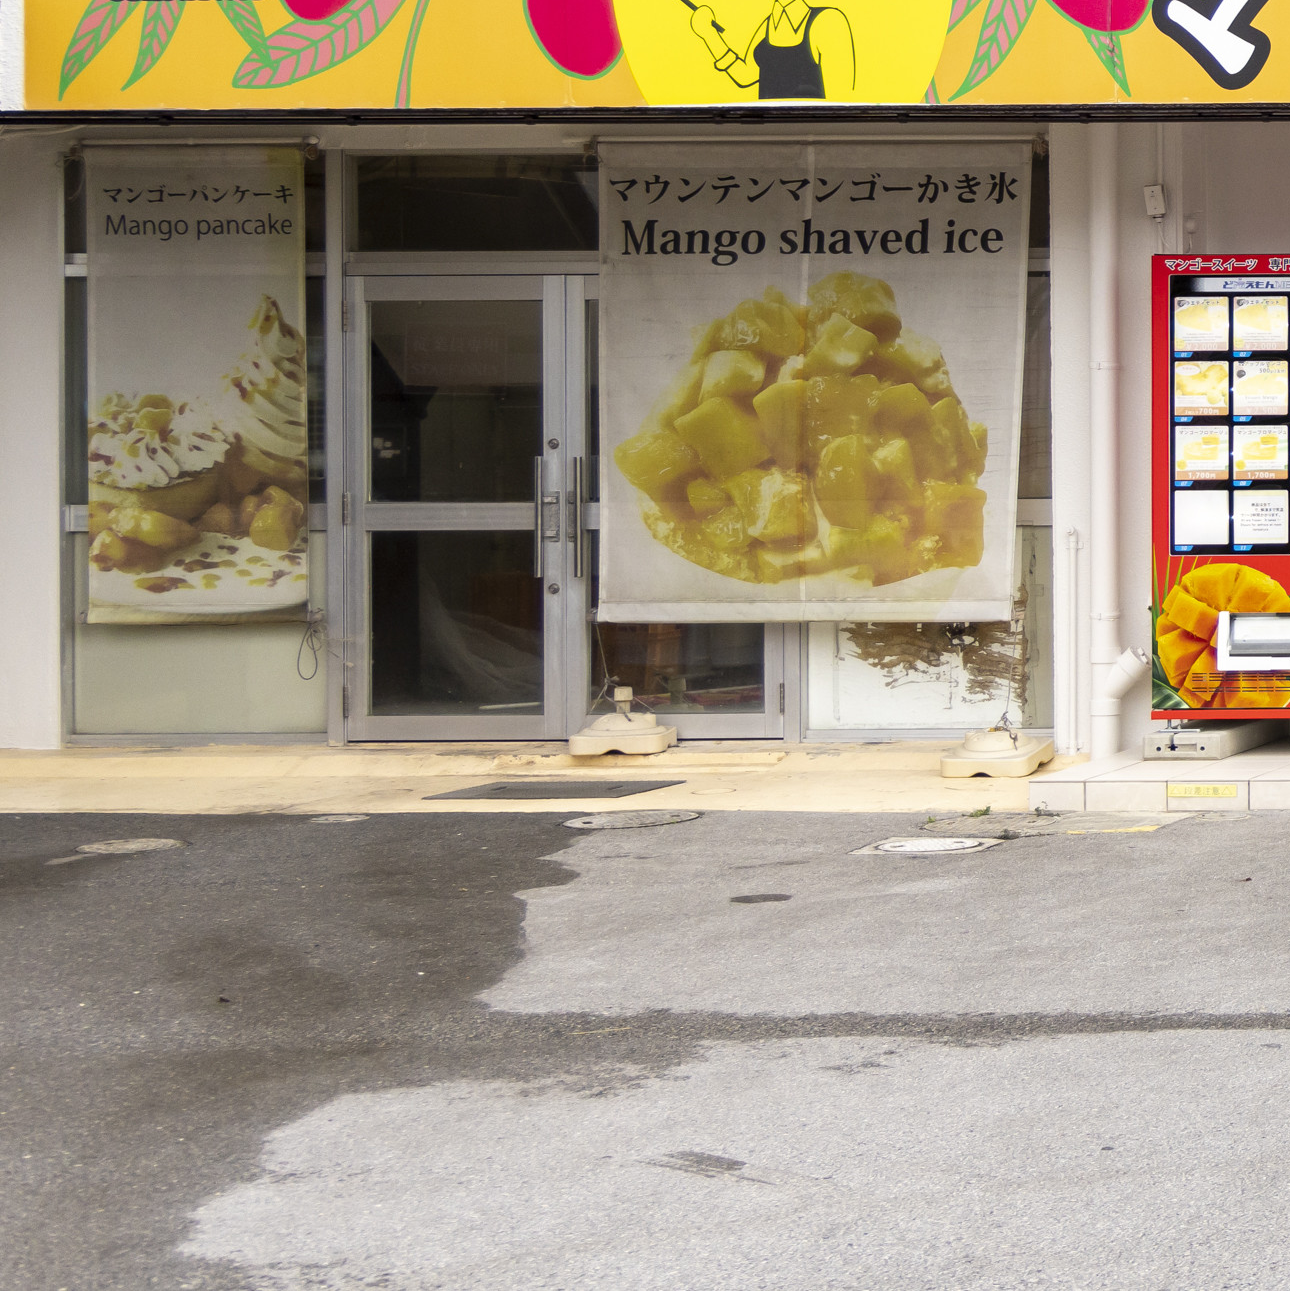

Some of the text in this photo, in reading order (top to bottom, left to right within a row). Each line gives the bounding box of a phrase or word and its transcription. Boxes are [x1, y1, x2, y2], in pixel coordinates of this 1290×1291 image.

[102, 184, 295, 206] マンゴーパンケーキ
[607, 173, 1019, 207] マウンテンマンゴーかき氷
[104, 213, 294, 242] Mango pancake
[620, 217, 1004, 266] Mango shaved ice
[1165, 258, 1258, 271] マンゴースイーツ
